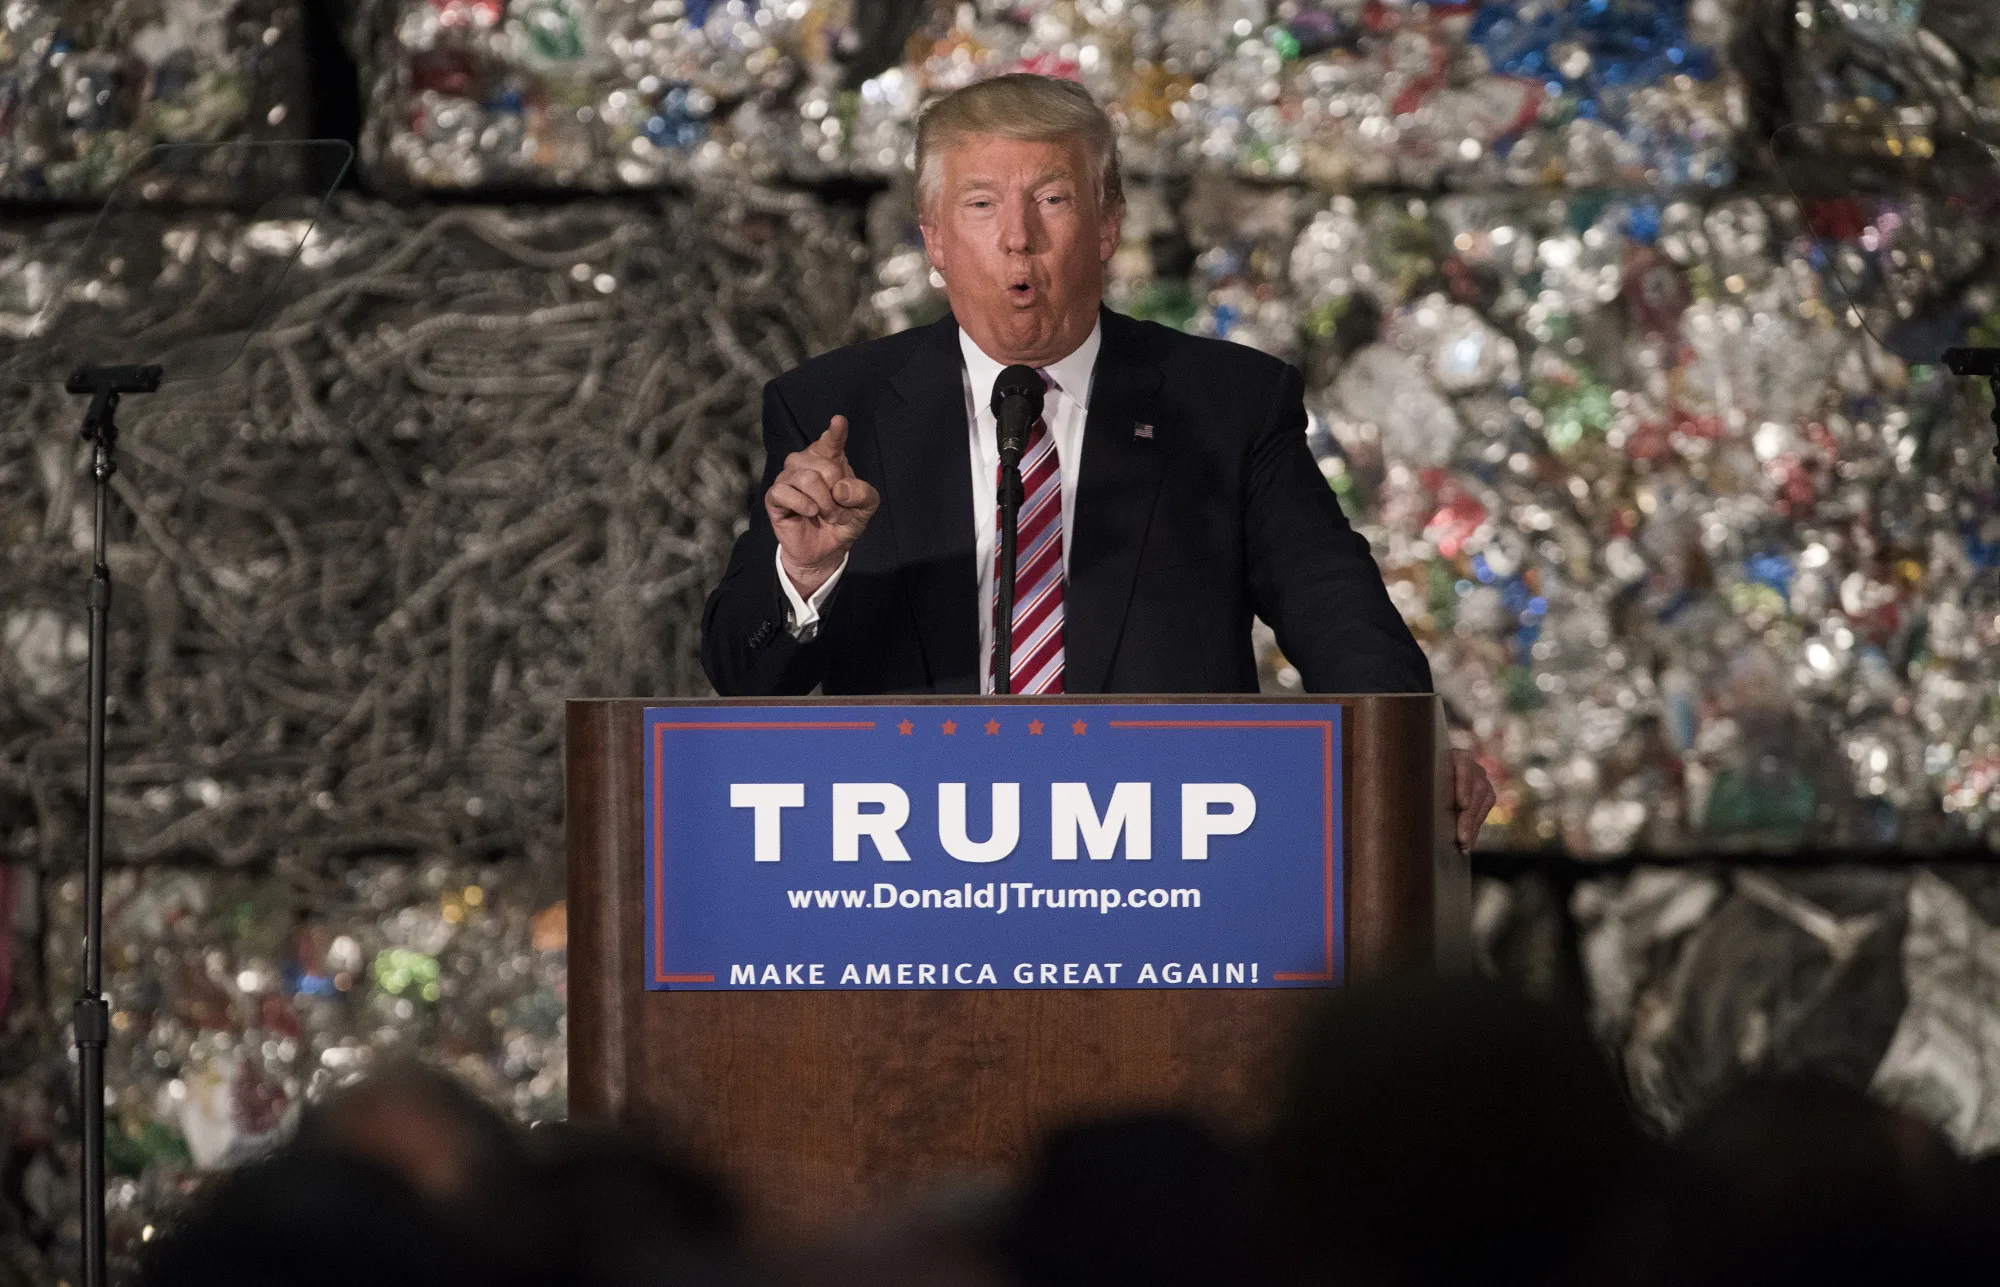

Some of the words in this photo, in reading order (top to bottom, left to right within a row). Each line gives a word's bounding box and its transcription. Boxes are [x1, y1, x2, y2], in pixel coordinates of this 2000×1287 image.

[730, 782, 1257, 862] TRUMP
[787, 882, 1201, 915] www.DonaldJTrump.com
[730, 963, 825, 985] MAKE
[840, 963, 998, 985] AMERICA
[1014, 963, 1122, 985] GREAT
[1137, 962, 1259, 985] AGAIN!
